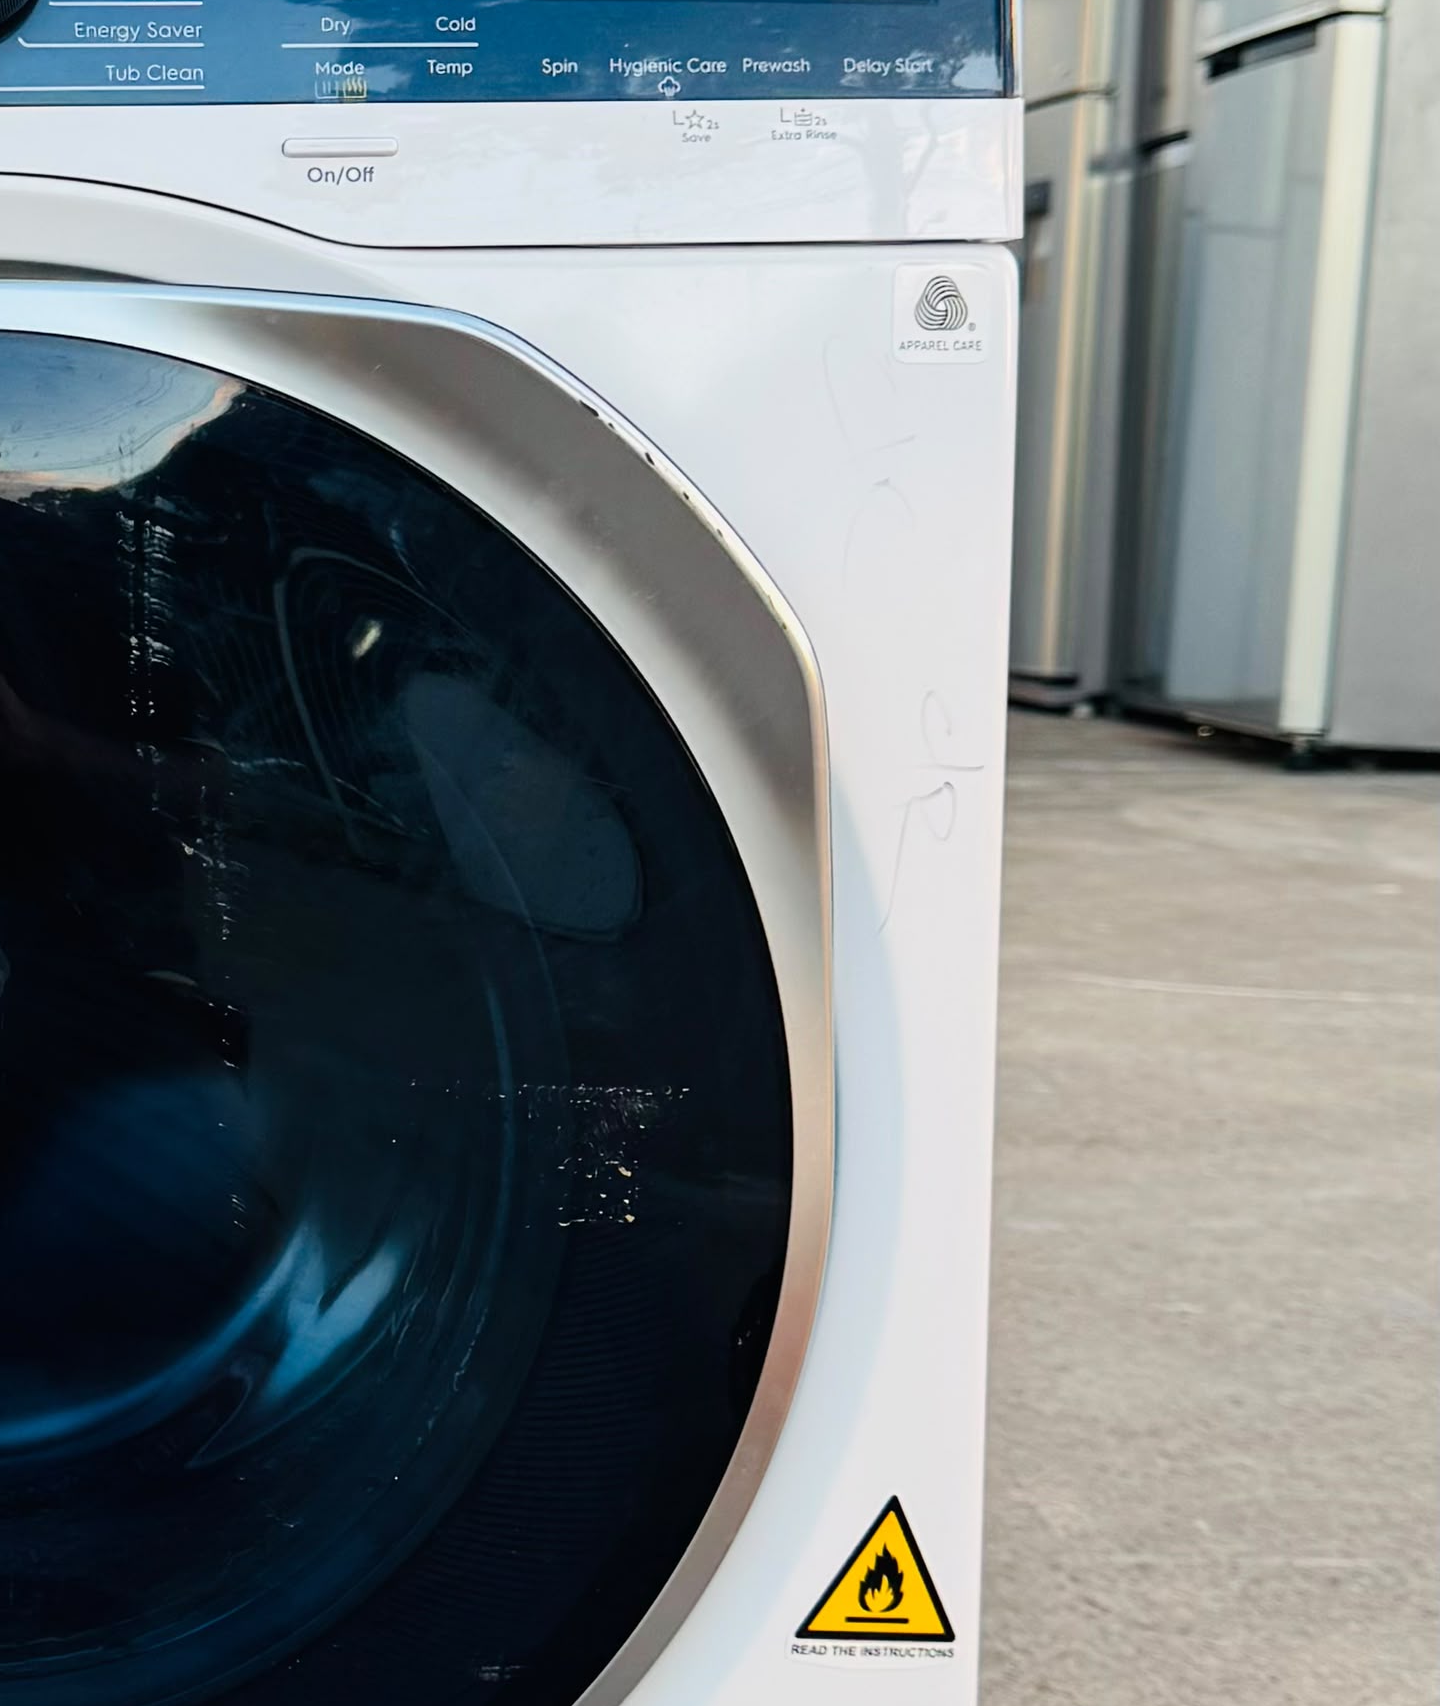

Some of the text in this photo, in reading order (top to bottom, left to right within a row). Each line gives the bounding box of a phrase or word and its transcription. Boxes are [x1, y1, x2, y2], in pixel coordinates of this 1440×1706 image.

[74, 22, 202, 42] Energy Saver
[320, 17, 350, 35] Dry
[435, 16, 476, 33] Cold
[105, 65, 204, 82] Tub Clean
[315, 61, 365, 76] Mode
[427, 59, 473, 78] Temp
[541, 58, 578, 77] Spin
[609, 58, 727, 77] Hygienic Care
[742, 58, 811, 74] Prewash
[843, 58, 933, 76] Delay Start
[681, 132, 712, 143] Save
[771, 129, 837, 141] Extra Rinse
[307, 166, 375, 185] On/Off
[899, 340, 949, 351] APPAREL
[791, 1644, 954, 1658] READ THE INSTRUCTIONS
